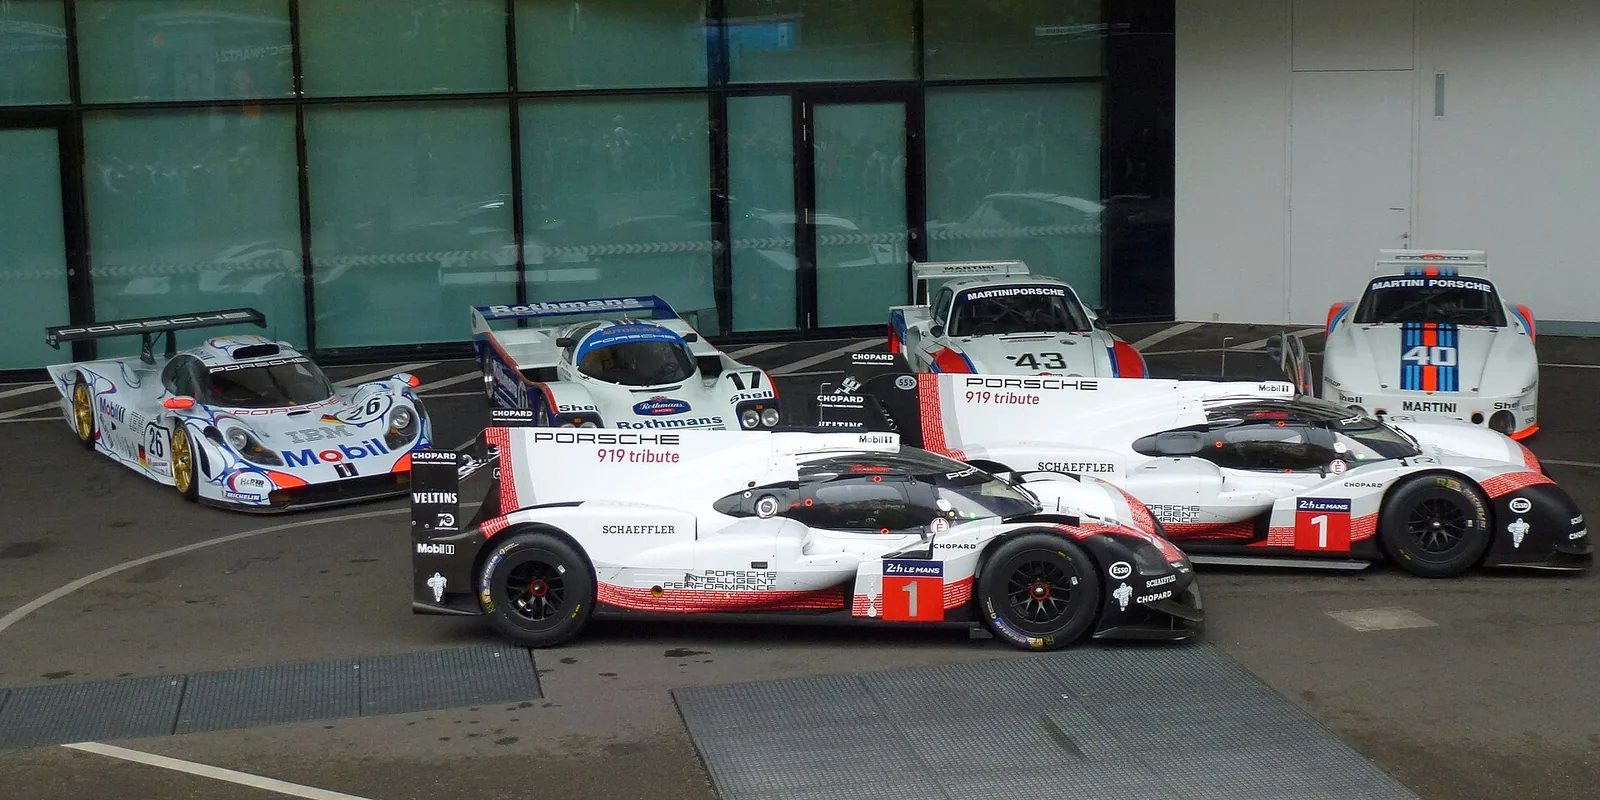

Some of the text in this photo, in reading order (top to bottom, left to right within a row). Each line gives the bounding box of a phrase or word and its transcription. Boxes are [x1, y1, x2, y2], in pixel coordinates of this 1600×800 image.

[1372, 280, 1491, 292] MARTINI PORSCHE
[489, 298, 641, 314] Rothmans
[58, 311, 252, 335] PORSCHE
[589, 334, 676, 347] PORSCHE
[852, 353, 894, 361] CHOPARD
[1015, 353, 1067, 369] 43
[1402, 346, 1457, 366] 40
[209, 357, 309, 374] PORSCHE
[726, 371, 761, 391] 17
[966, 378, 1098, 390] PORSCHE
[1258, 384, 1281, 392] Mobil
[730, 390, 773, 404] Shell
[817, 395, 864, 403] CHOPARD
[965, 391, 1040, 405] 919 tribute
[100, 397, 119, 422] Mobil
[232, 397, 341, 416] PORSCHE
[346, 398, 381, 421] 26
[638, 401, 685, 411] Rothmans
[1402, 401, 1457, 413] MARTINI
[616, 416, 723, 430] Rothmans
[285, 425, 354, 444] IBM
[534, 432, 680, 445] PORSCHE
[859, 435, 884, 443] Mobil
[149, 427, 164, 458] 26
[281, 438, 390, 468] Mobil
[412, 452, 457, 460] CHOPARD
[597, 448, 680, 463] 919 tribute
[1037, 462, 1115, 473] SCHAEFFLER
[227, 492, 261, 501] MICHELIN
[413, 492, 458, 504] VELTINS
[438, 513, 455, 527] 70
[602, 525, 676, 534] SCHAEFFLER
[1311, 515, 1328, 548] 1
[417, 543, 445, 554] Mobil
[705, 569, 777, 578] PORSCHE
[886, 563, 904, 573] 24h
[1112, 565, 1130, 575] Esso
[684, 573, 777, 584] INTELLIGENT
[1146, 574, 1176, 588] SCHAEFFLER
[664, 581, 777, 591] PERFORMANCE
[901, 580, 918, 617] 1
[1136, 590, 1173, 605] CHOPARD
